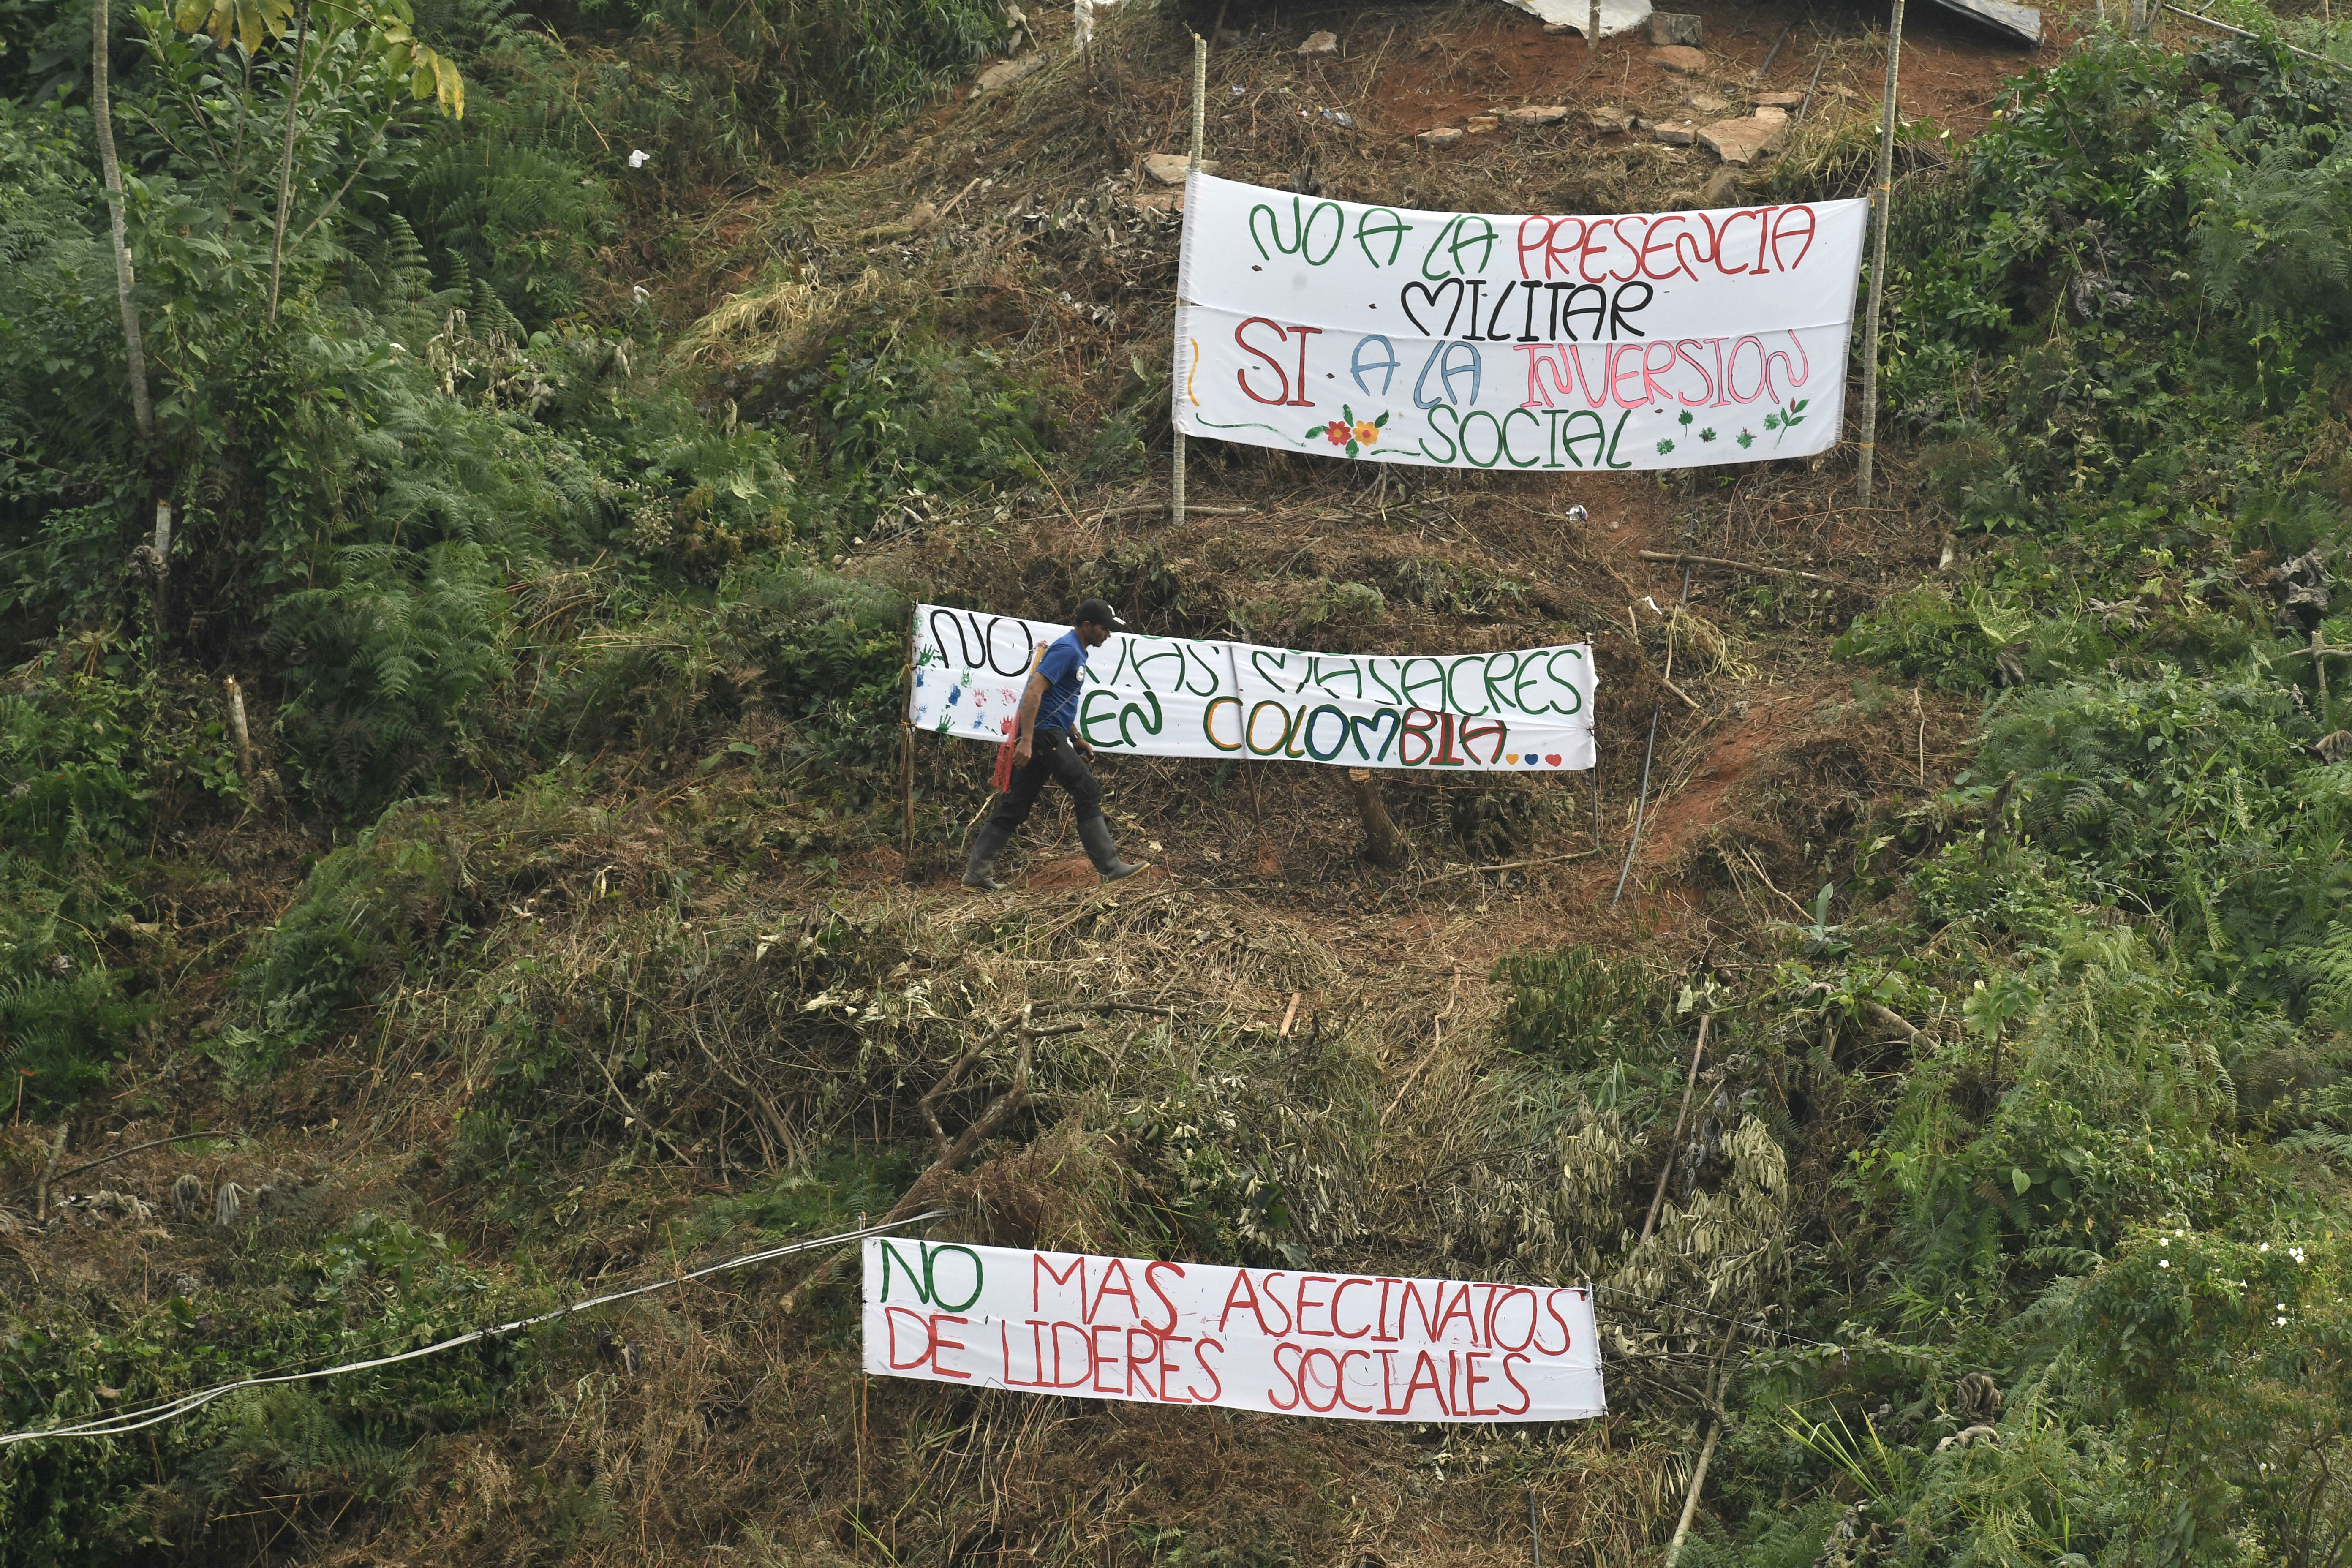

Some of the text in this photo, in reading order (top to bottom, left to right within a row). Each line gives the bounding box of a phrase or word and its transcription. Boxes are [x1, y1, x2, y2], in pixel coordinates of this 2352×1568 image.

[1249, 196, 1816, 283] NO A LA PRESENCIA
[1401, 278, 1653, 342] MILITAR
[1234, 317, 1809, 409] SI A LA INVERSION
[1418, 404, 1632, 468] SOCIAL
[930, 609, 1033, 677] NO
[1252, 649, 1582, 716] MASACRES
[1080, 689, 1511, 766] EN COLOMBIA
[880, 1239, 1585, 1356] NO MAS ASECINATOS
[884, 1306, 1531, 1417] DE LIDERES SOCIALES
